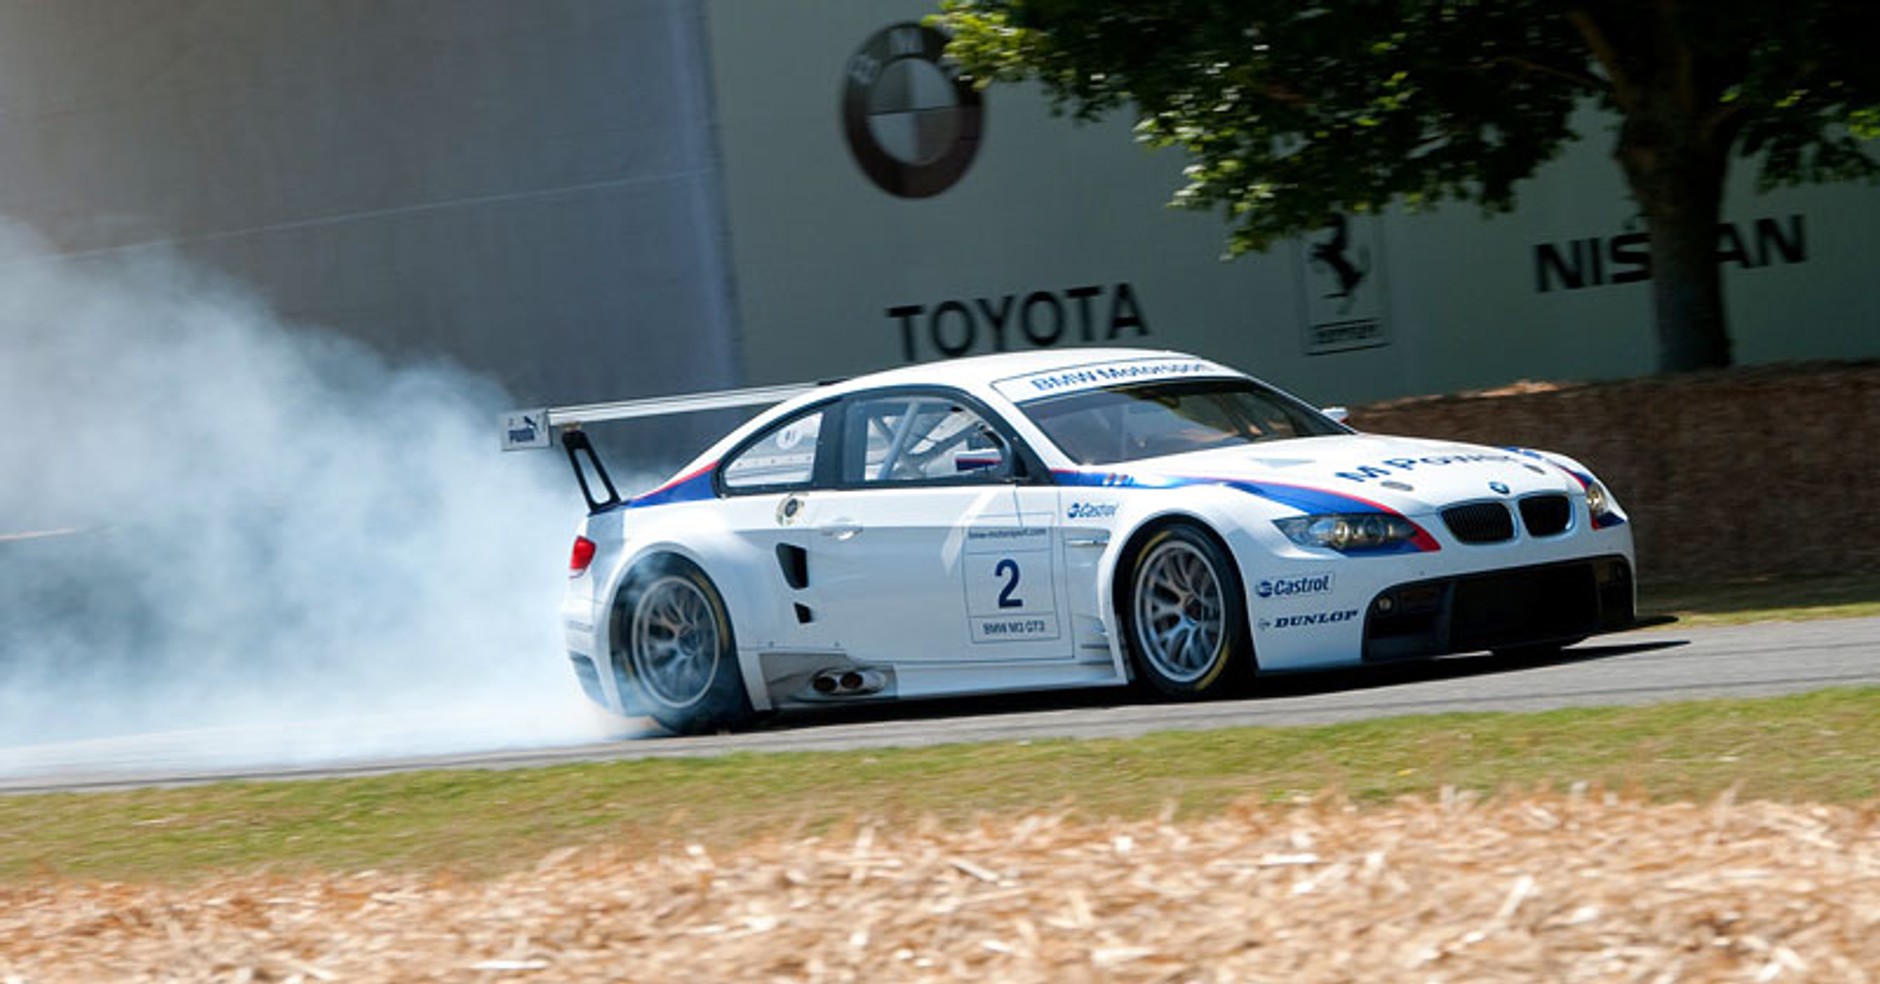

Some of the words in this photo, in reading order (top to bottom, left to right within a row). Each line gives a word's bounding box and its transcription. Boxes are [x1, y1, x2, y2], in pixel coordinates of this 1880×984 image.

[886, 283, 1149, 361] TOYOTA
[1030, 371, 1097, 391] BMW
[1334, 465, 1391, 482] M
[994, 559, 1023, 608] 2
[1274, 575, 1329, 595] Castrol
[1274, 610, 1358, 628] DUNLOP
